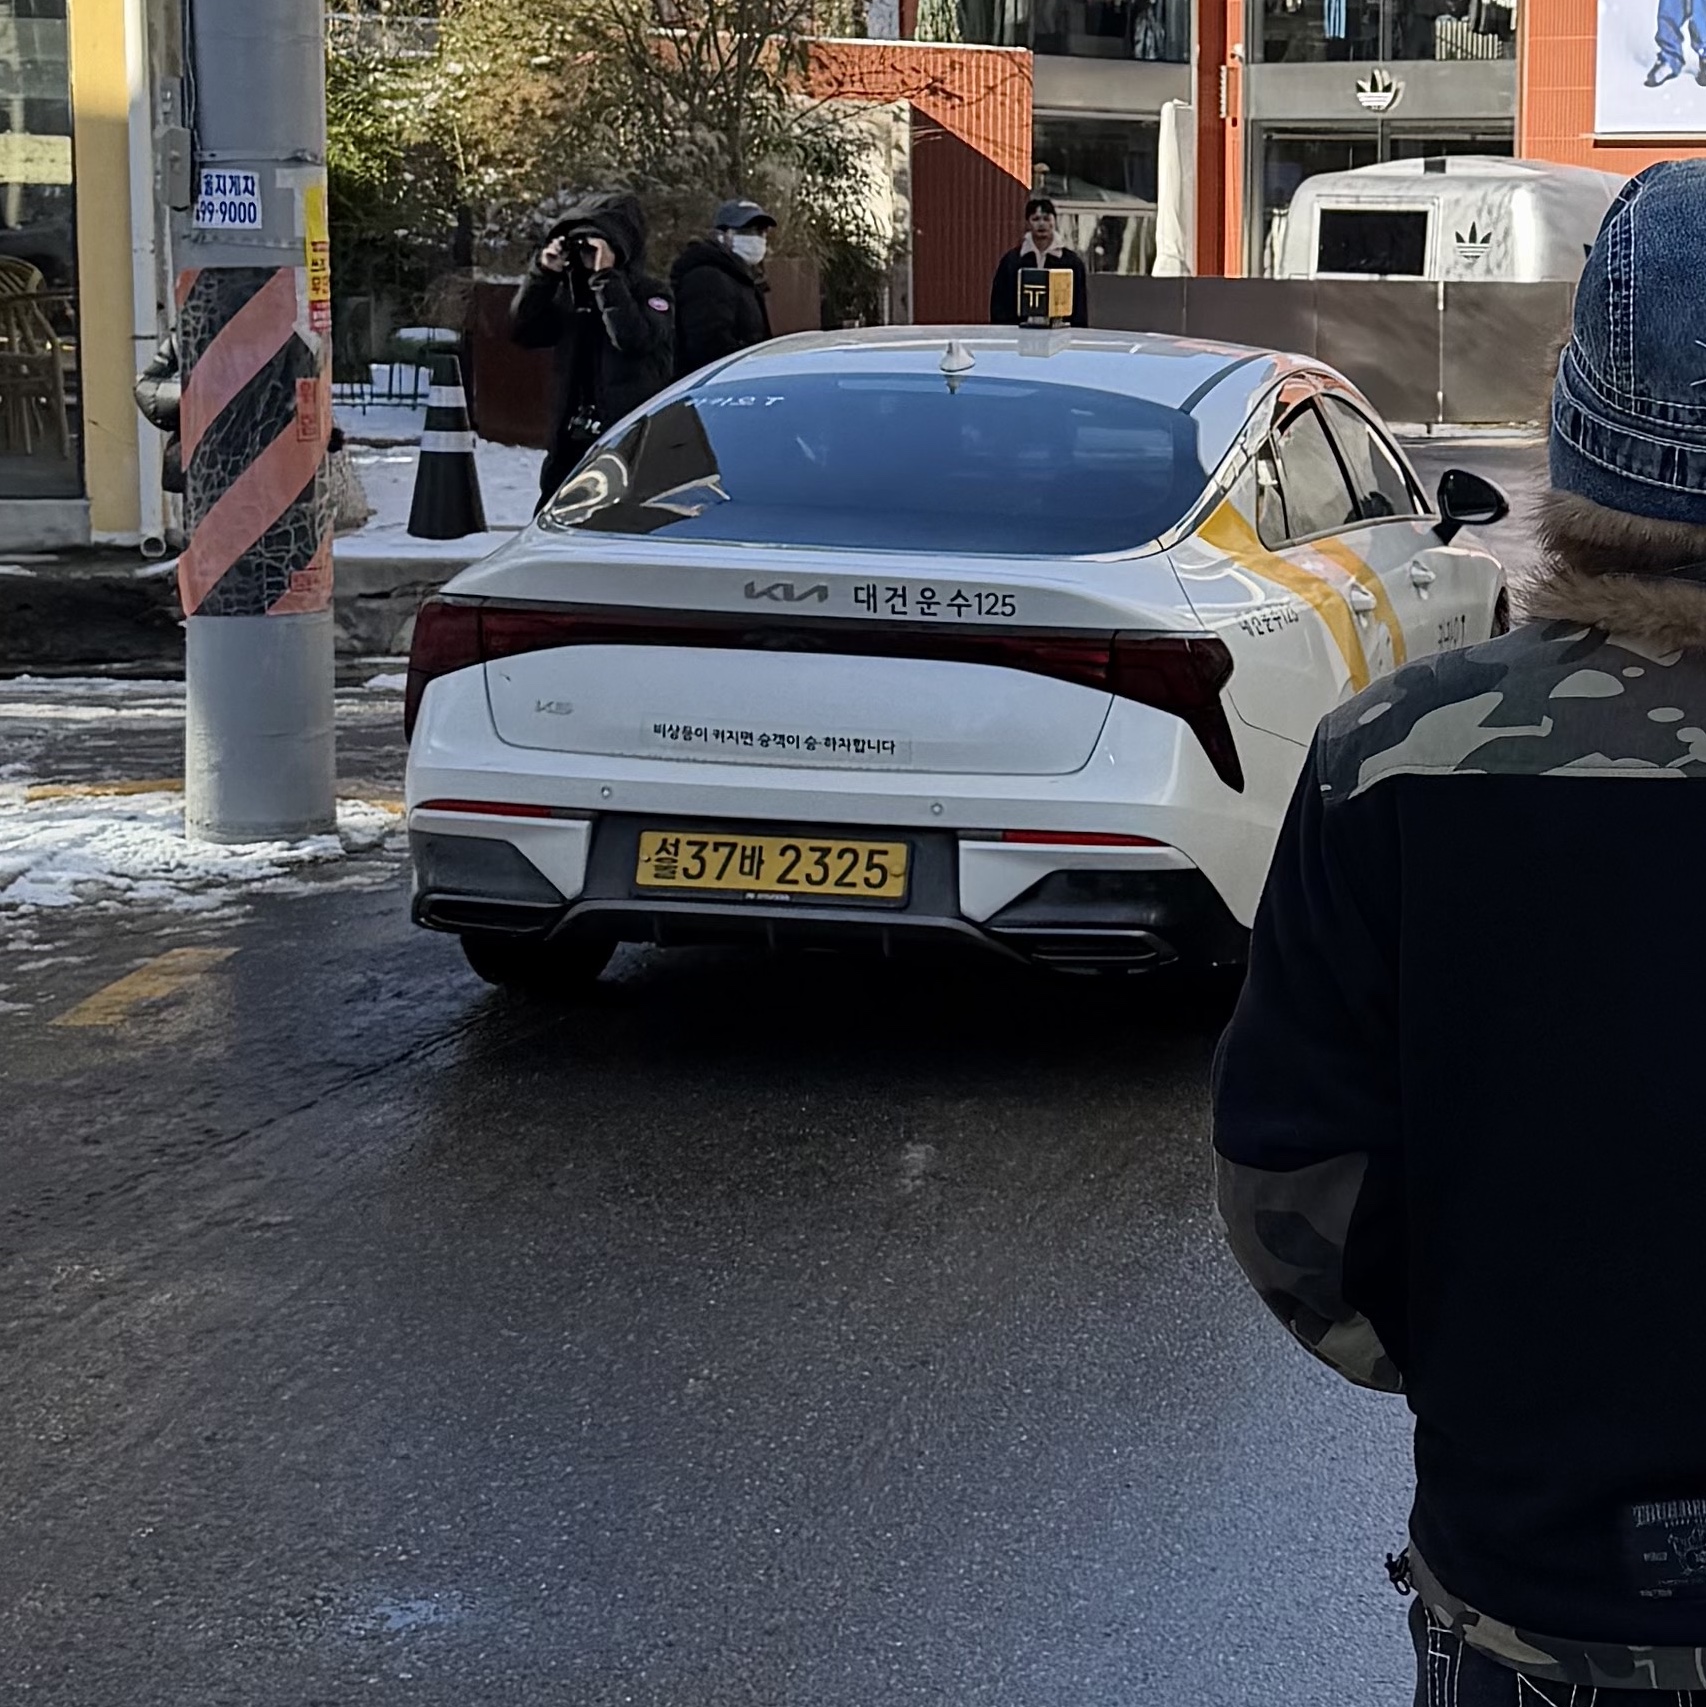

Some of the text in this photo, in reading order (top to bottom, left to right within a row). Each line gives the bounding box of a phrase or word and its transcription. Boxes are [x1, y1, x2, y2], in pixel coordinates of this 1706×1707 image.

[744, 581, 828, 602] KIA
[854, 583, 1017, 617] 대건운수125
[776, 844, 889, 889] 2325
